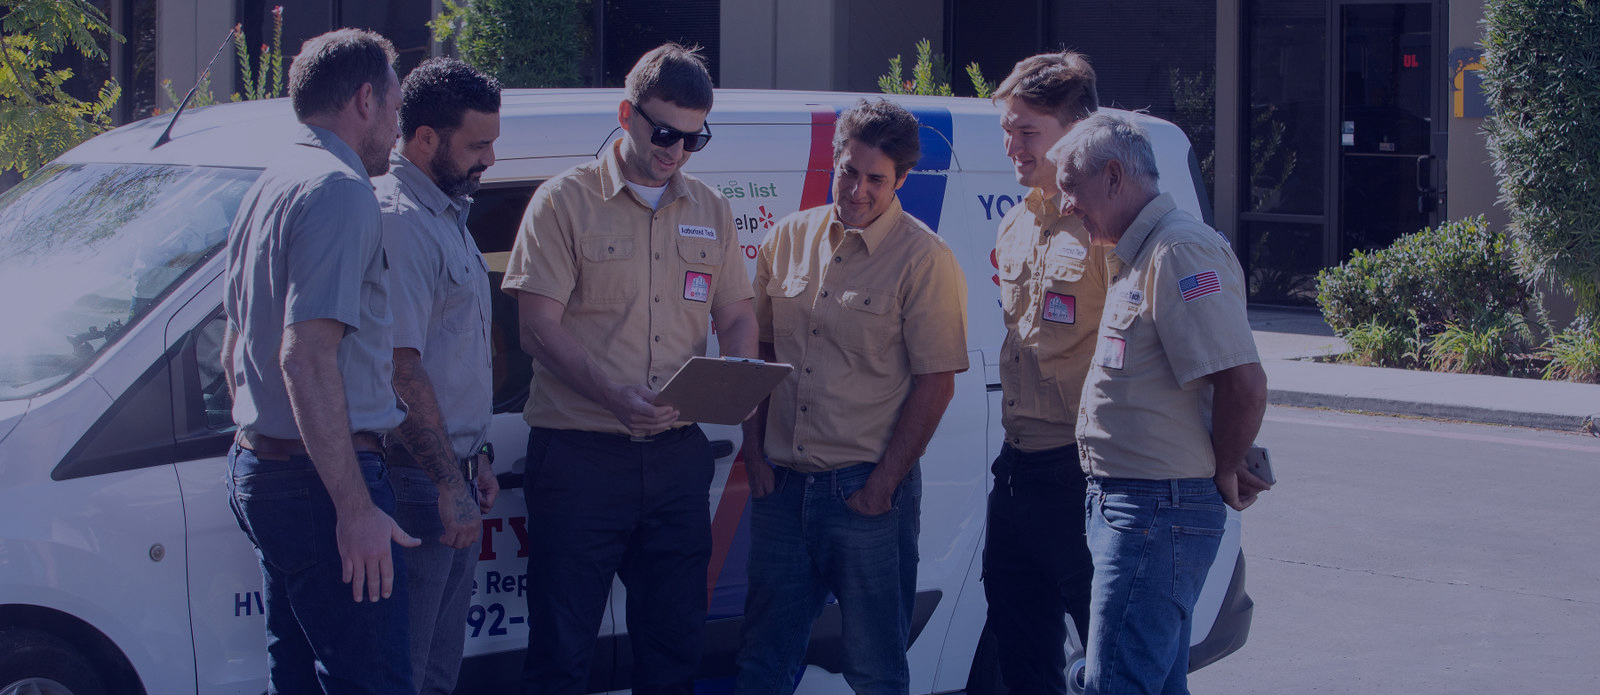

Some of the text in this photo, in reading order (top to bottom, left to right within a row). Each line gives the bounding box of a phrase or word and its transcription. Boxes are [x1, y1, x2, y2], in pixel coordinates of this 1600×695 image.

[749, 181, 778, 198] list
[977, 194, 1023, 220] YO
[735, 214, 758, 233] elp
